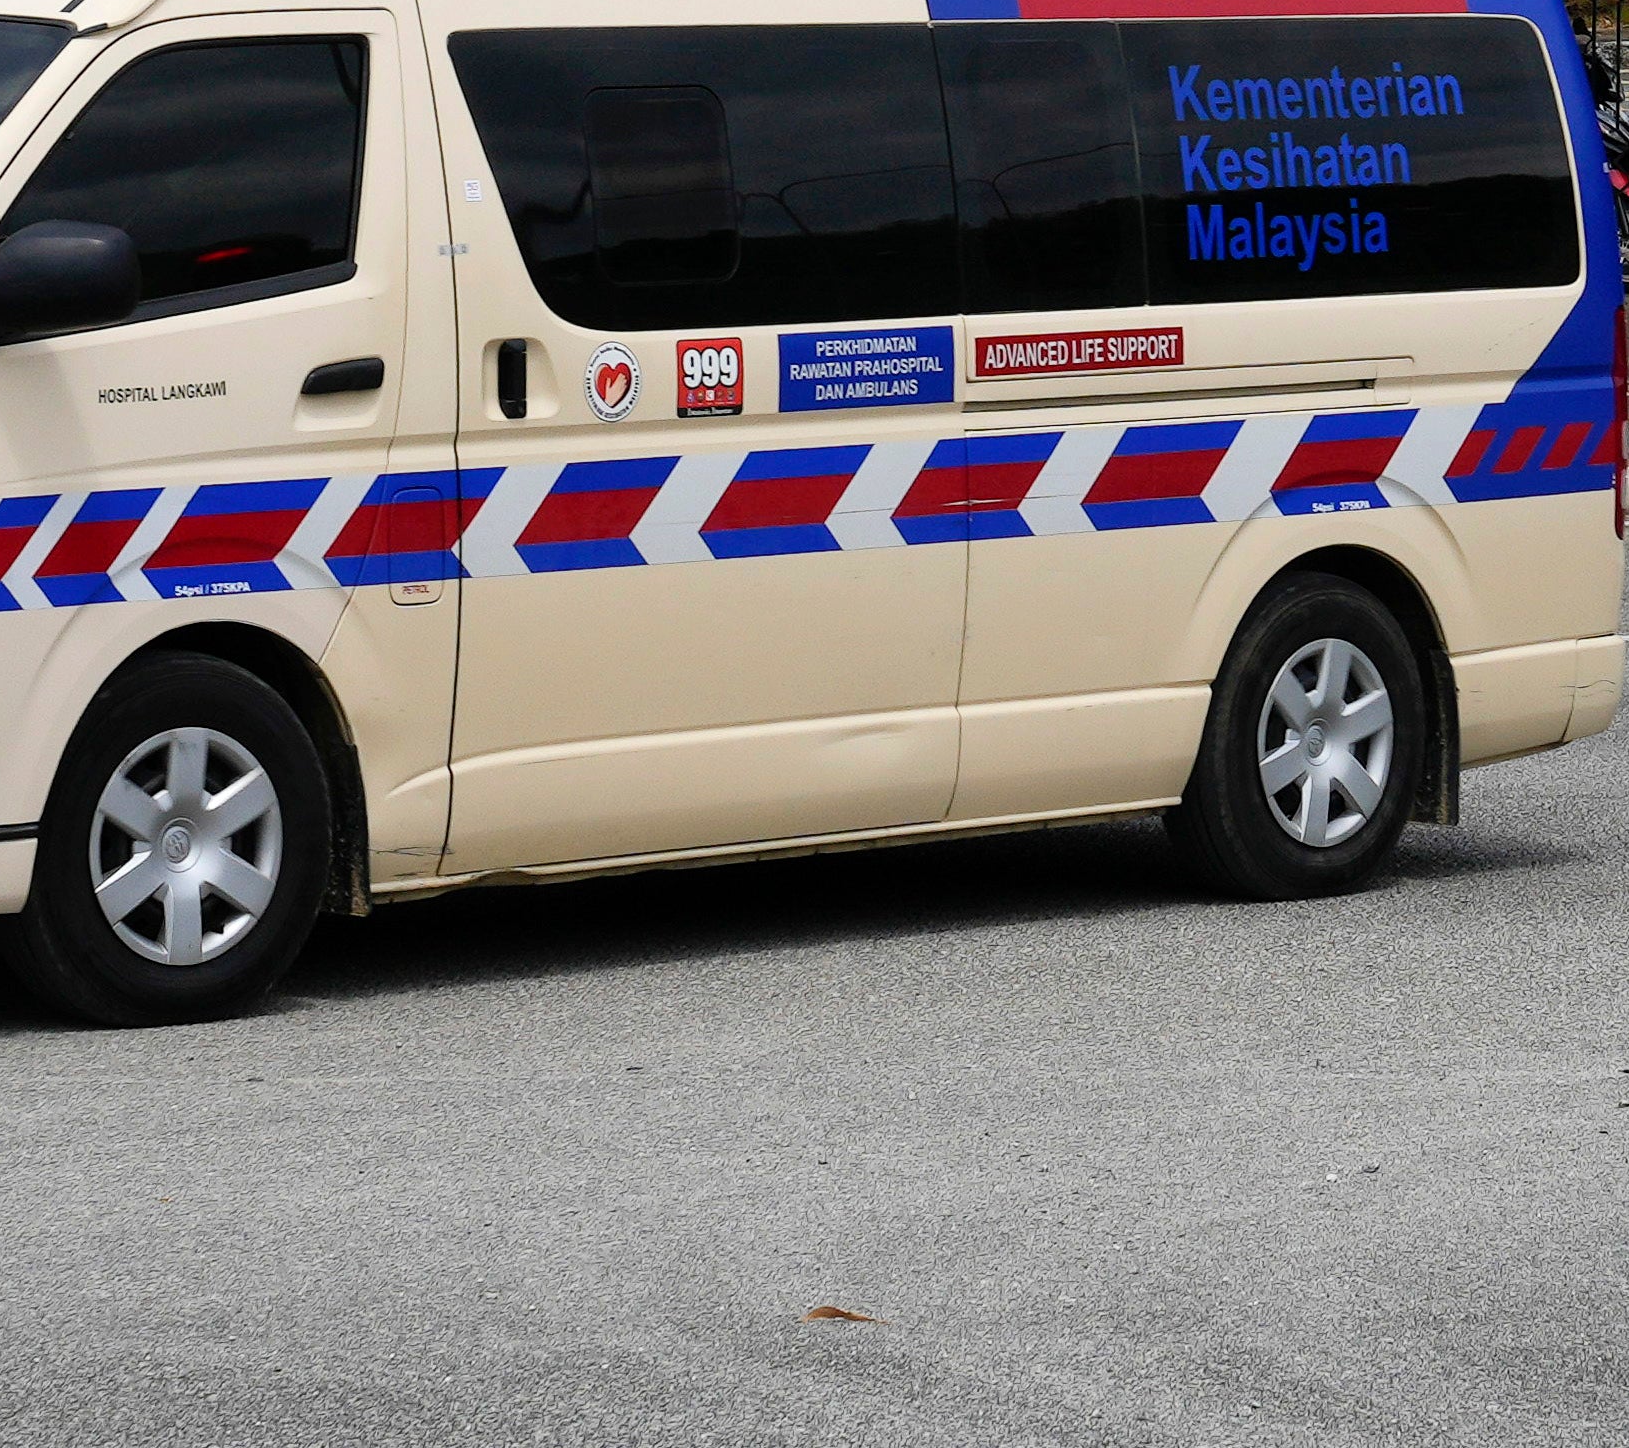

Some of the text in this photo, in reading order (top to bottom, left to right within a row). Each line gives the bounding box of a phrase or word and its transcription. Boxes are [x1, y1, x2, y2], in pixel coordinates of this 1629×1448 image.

[1168, 61, 1464, 122] Kementerian
[1179, 131, 1412, 192] Kesihatan
[1186, 198, 1390, 272] Malaysia
[815, 336, 917, 357] PERKHIDMATAN
[984, 334, 1179, 370] ADVANCED LIFE SUPPORT
[682, 347, 739, 389] 999
[790, 356, 943, 380] RAWATAN PRAHOSPITAL
[98, 380, 227, 404] HOSPITAL LANGKAWI
[815, 380, 919, 401] DAN AMBULANS
